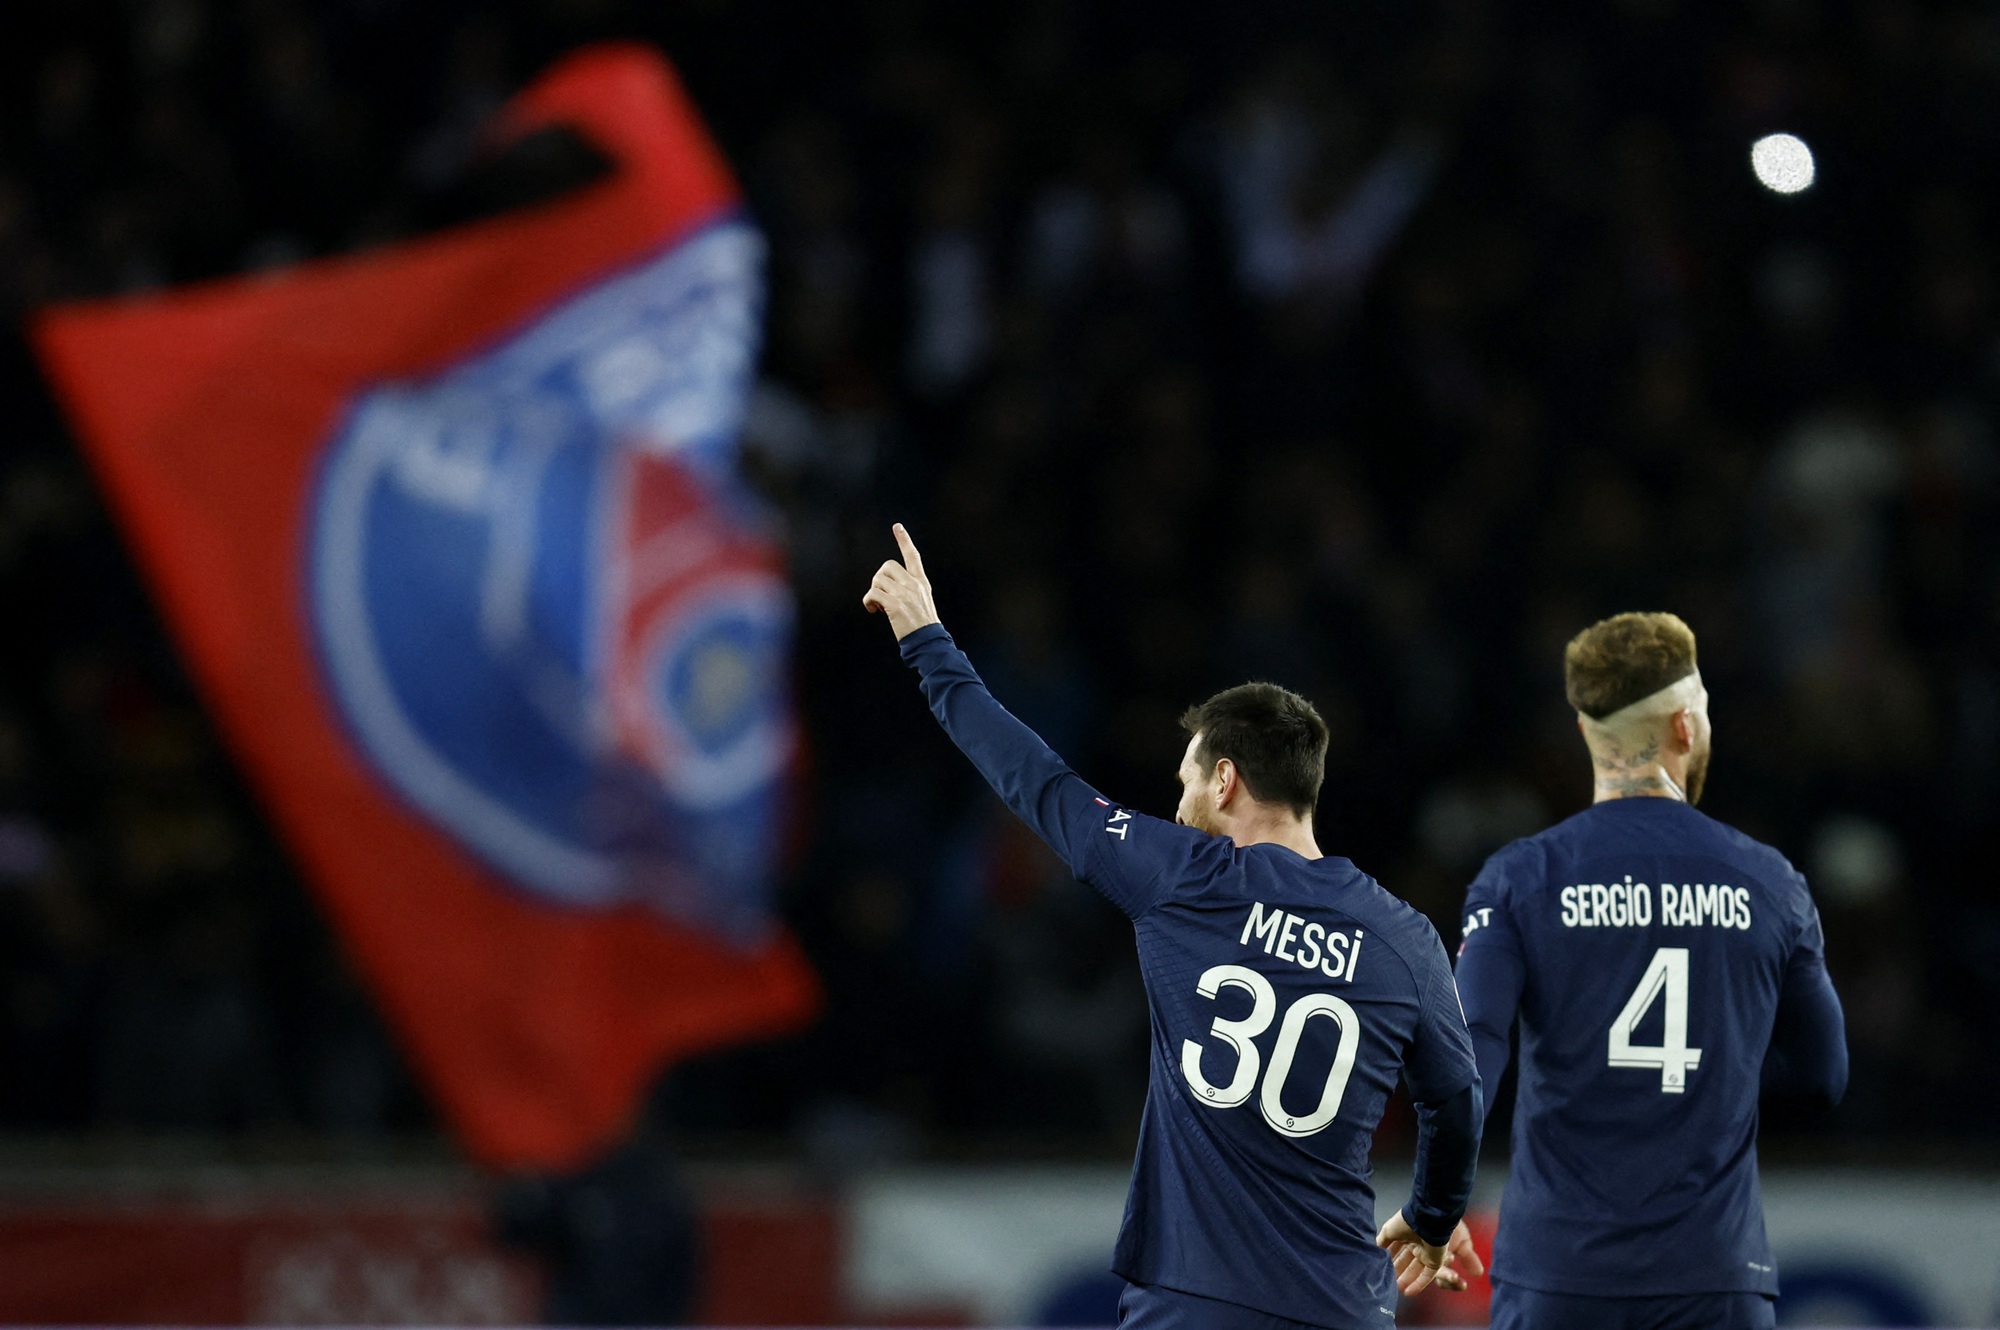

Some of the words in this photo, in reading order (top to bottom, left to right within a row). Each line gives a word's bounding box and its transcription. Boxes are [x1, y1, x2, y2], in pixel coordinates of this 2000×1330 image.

[1105, 807, 1134, 841] AT
[1660, 883, 1752, 931] RAMOS
[1180, 964, 1360, 1138] 30
[1607, 947, 1703, 1094] 4
